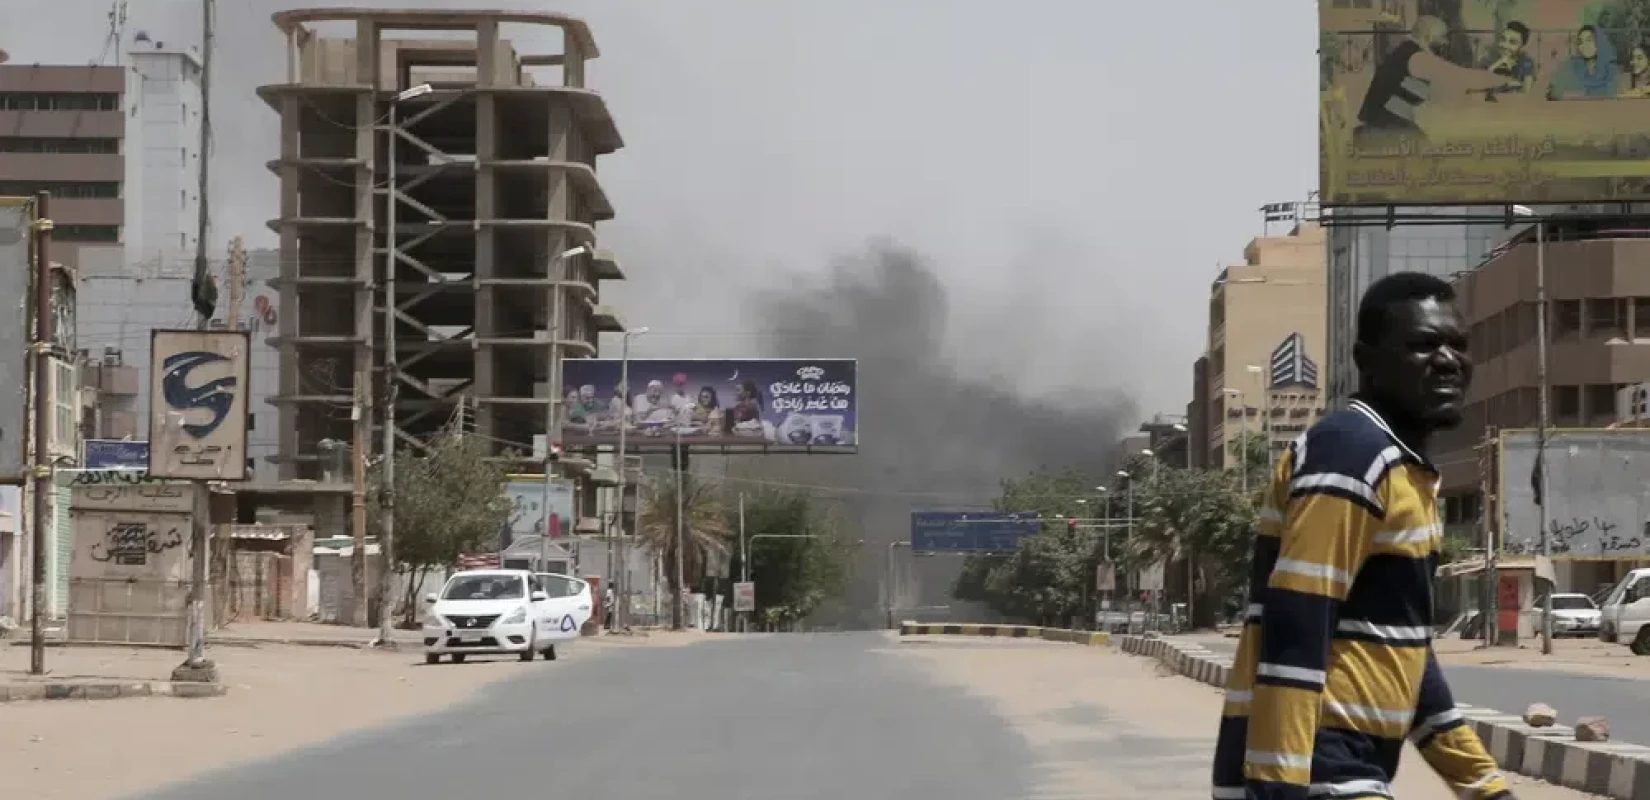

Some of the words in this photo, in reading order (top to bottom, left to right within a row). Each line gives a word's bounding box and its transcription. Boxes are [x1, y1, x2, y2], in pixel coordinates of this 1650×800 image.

[769, 380, 802, 397] عادي
[803, 383, 815, 394] ما
[817, 381, 851, 395] رمضان
[772, 397, 804, 413] زبادي
[830, 396, 849, 409] من
